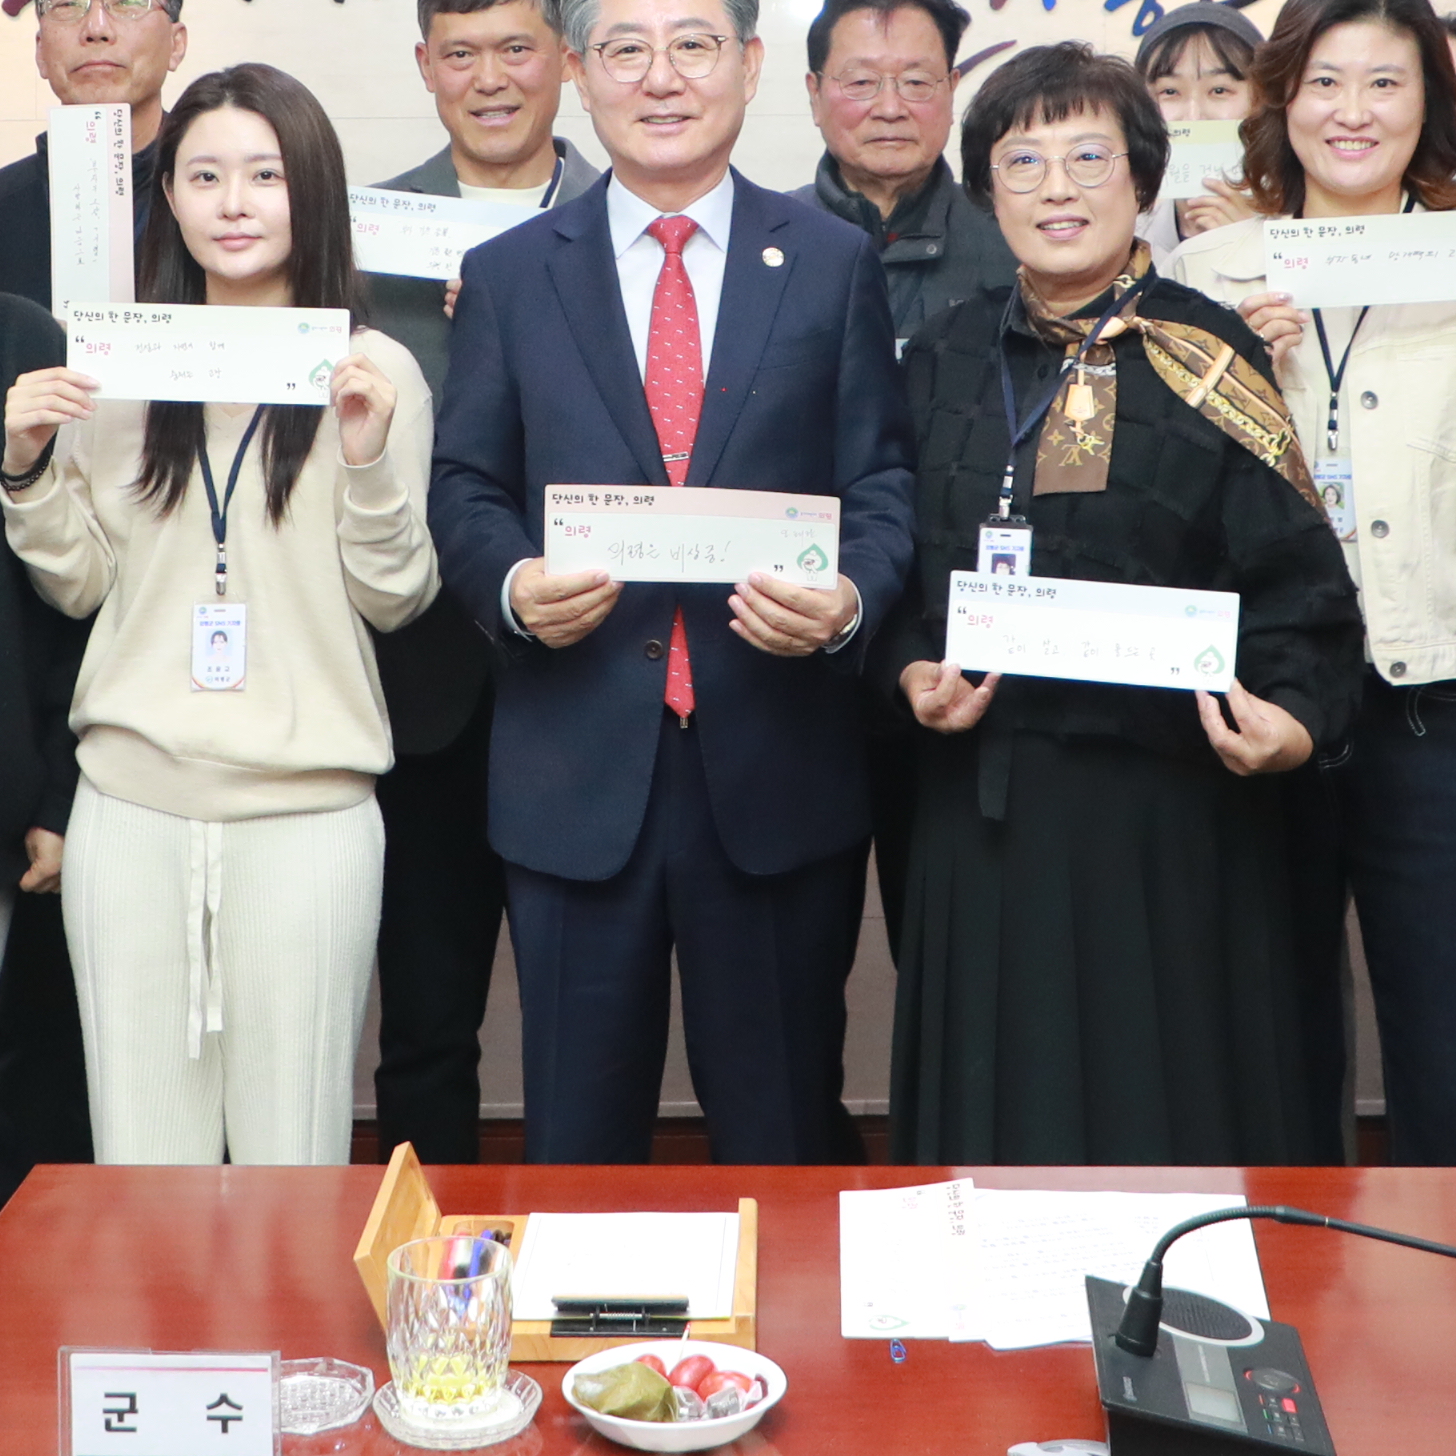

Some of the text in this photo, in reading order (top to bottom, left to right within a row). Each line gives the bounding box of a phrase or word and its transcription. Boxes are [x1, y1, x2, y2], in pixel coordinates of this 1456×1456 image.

[350, 194, 377, 206] 당신의
[418, 202, 436, 212] 의령
[1270, 224, 1365, 238] 당신의 한 문장, 의령
[1284, 256, 1309, 270] 의령
[74, 310, 172, 324] 당신의 한 문장, 의령
[86, 343, 111, 355] 의령
[552, 494, 654, 506] 당신의 한 문장, 의령
[565, 526, 591, 538] 의령
[957, 580, 1056, 599] 당신의 한 문장, 의령
[968, 615, 993, 628] 의령
[103, 1392, 243, 1434] 군 수
